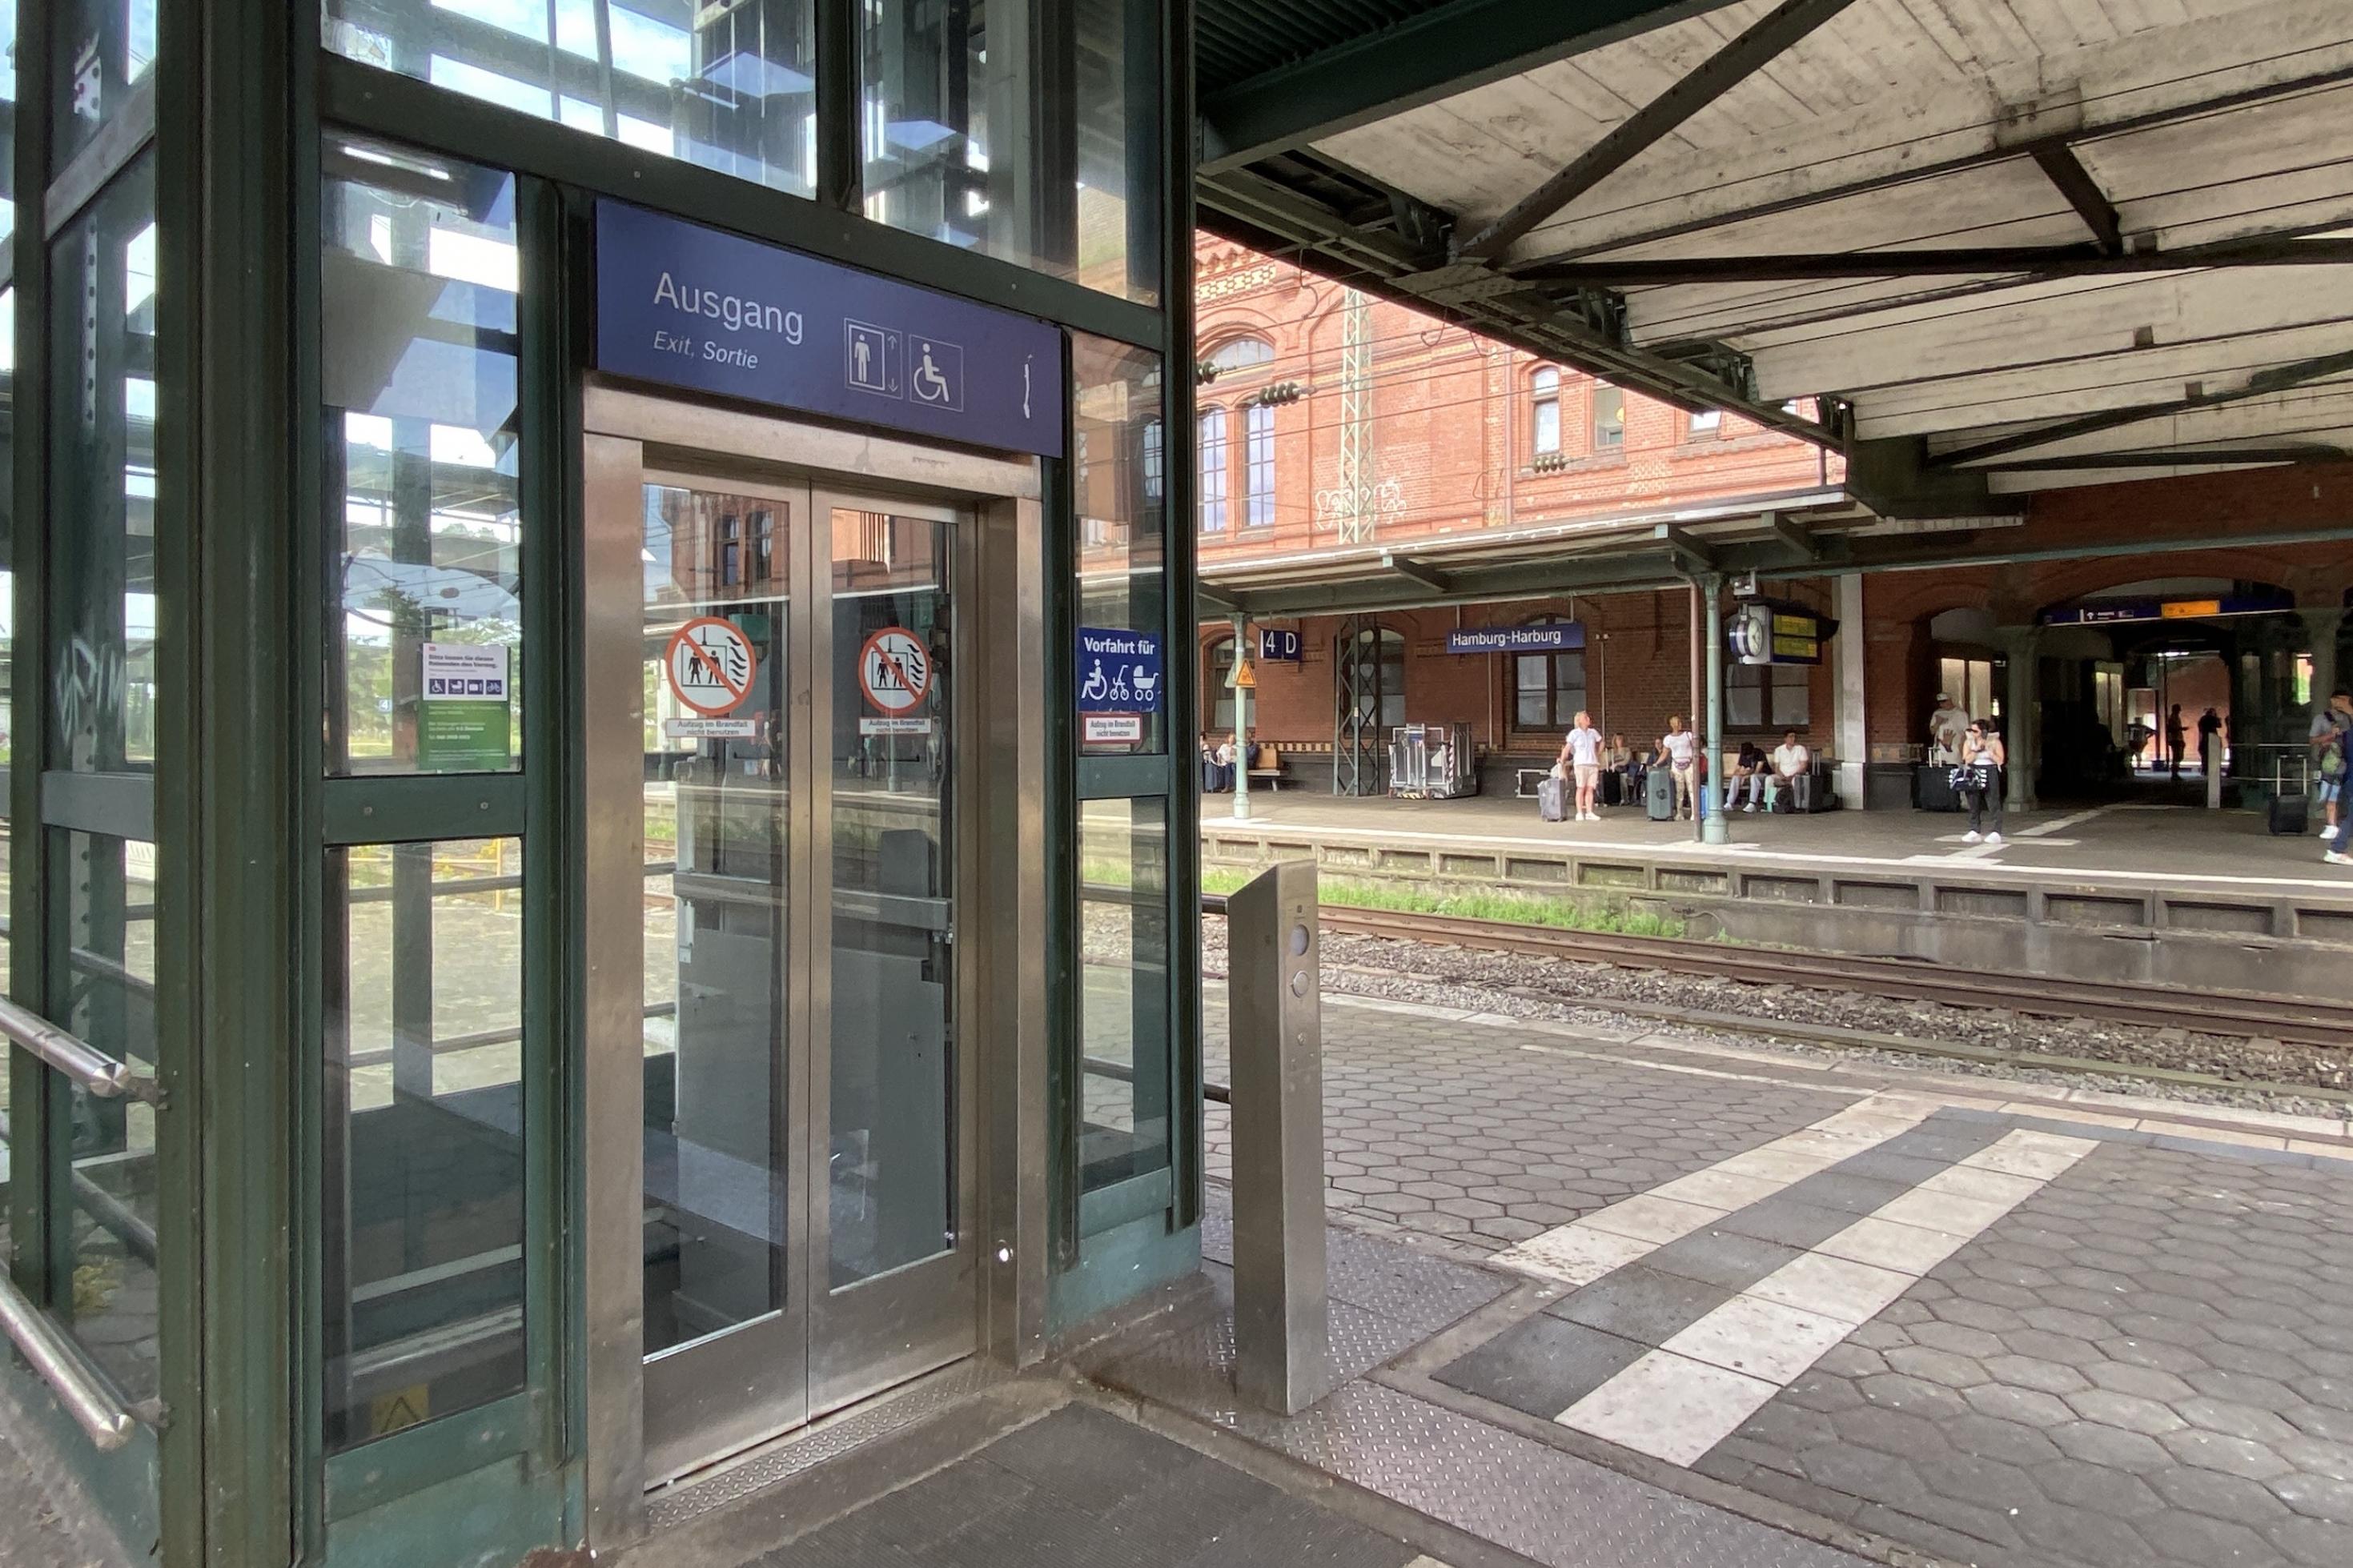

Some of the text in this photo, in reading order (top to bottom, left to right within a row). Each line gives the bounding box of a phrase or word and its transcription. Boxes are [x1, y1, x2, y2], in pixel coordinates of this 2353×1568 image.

[653, 272, 802, 345] Ausgang
[653, 331, 758, 369] Exit, Sortie
[1083, 636, 1155, 655] Vorfahrt für
[1266, 631, 1297, 654] 4 D
[1452, 630, 1561, 647] Hamburg-Harburg
[1090, 720, 1106, 729] Aufzug
[1114, 720, 1135, 728] Brandfall
